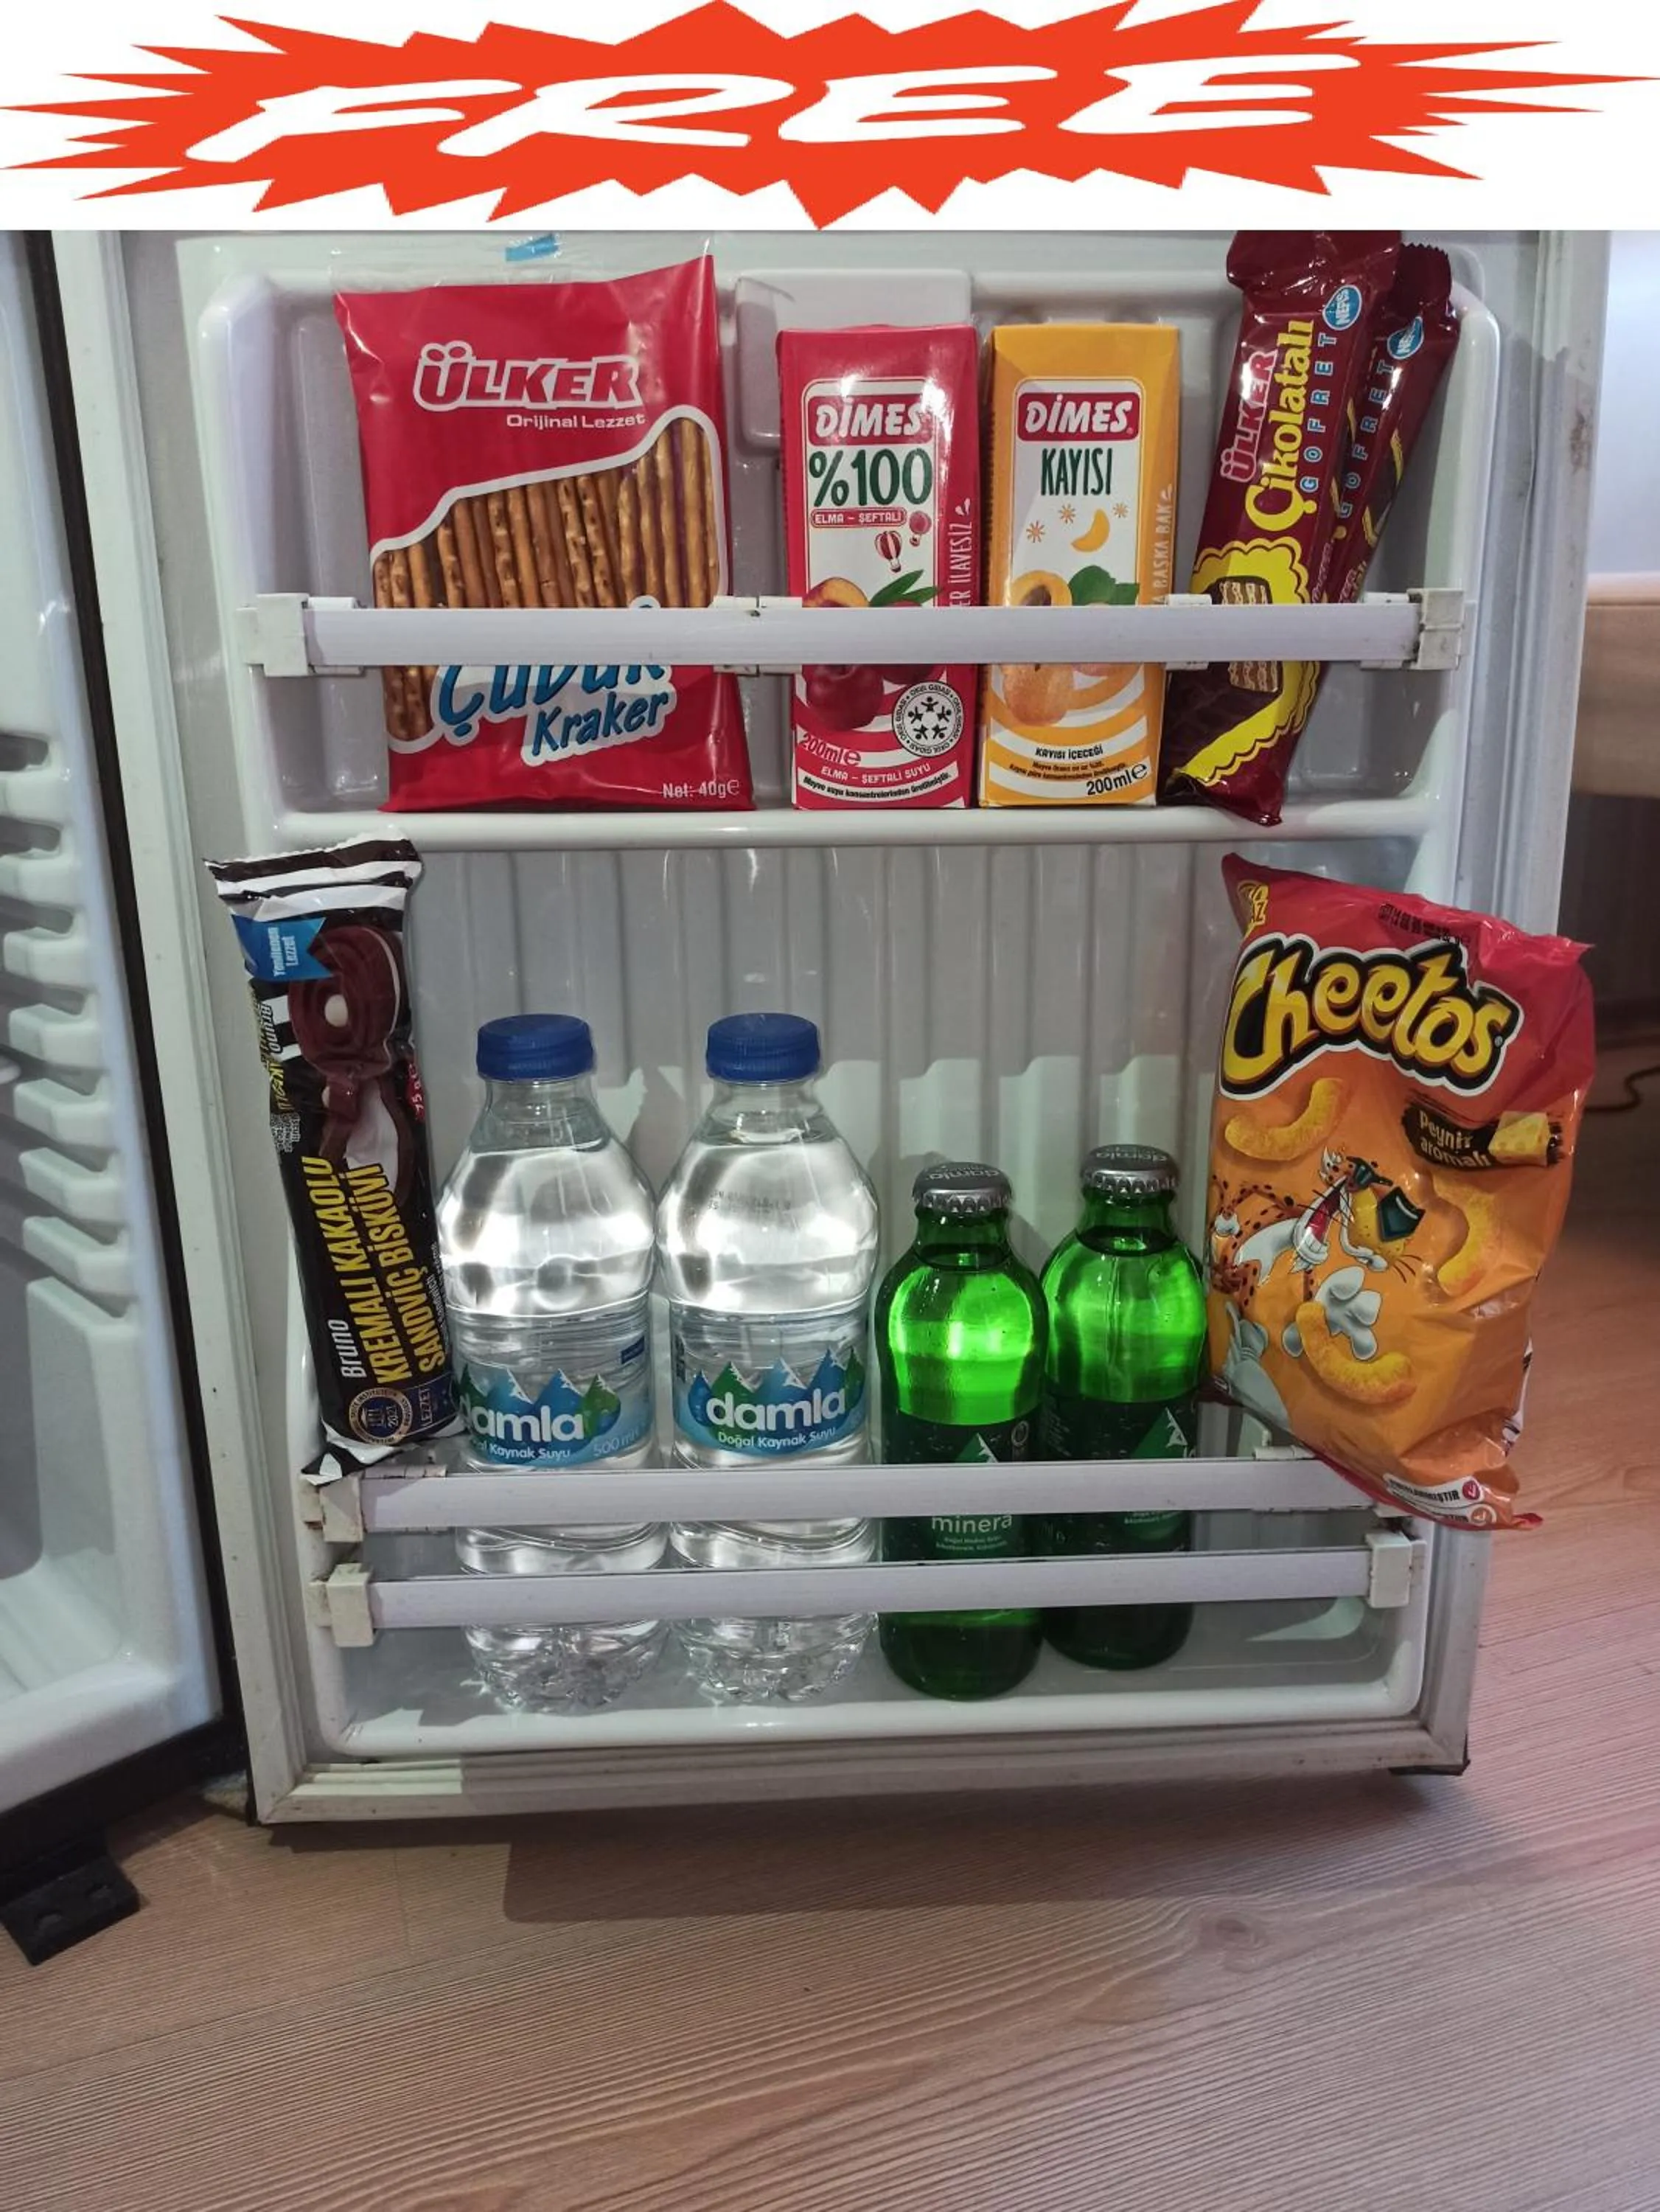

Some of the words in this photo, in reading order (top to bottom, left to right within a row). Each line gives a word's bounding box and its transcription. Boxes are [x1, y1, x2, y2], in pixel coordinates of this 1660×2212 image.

[414, 340, 644, 411] ÜLKER
[507, 414, 577, 430] Orijinal
[582, 414, 646, 428] Lezzet
[1025, 394, 1132, 434] DİMES
[1220, 349, 1278, 484] ÜLKER
[1300, 333, 1337, 493] GOFRET
[809, 448, 933, 507] %100
[1041, 448, 1113, 495] KAYISI
[815, 514, 845, 524] ELMA
[531, 690, 669, 756] Kraker
[1221, 942, 1516, 1088] Cheetos
[301, 1156, 371, 1273] KAKAOLU
[328, 1319, 367, 1379] Bruno
[341, 1277, 414, 1385] KREMALI
[706, 1388, 845, 1430] damla
[718, 1431, 754, 1448] Doğal
[758, 1433, 806, 1450] Kaynak
[810, 1427, 836, 1443] Suyu
[489, 1443, 535, 1459] Kaynak
[539, 1448, 571, 1461] Suyu
